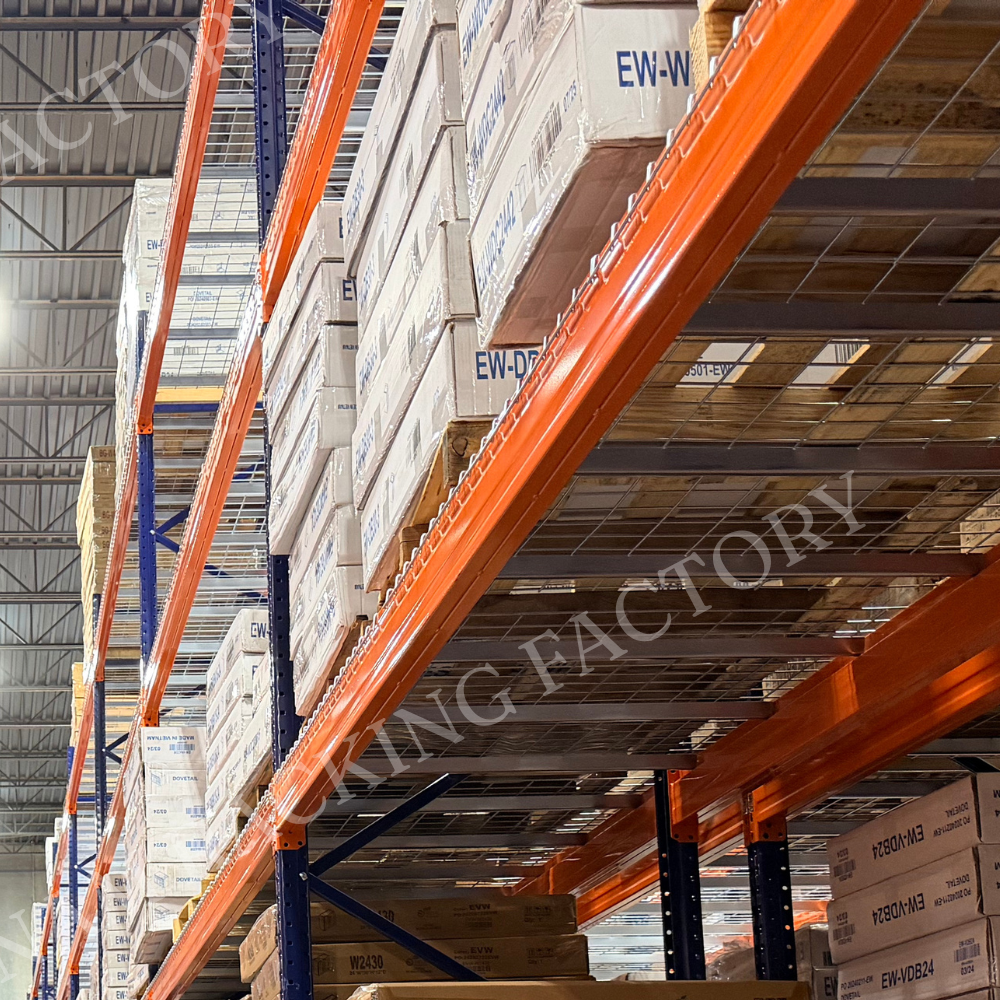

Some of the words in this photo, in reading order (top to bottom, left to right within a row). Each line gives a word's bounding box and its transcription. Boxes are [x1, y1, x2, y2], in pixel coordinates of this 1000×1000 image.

[945, 802, 968, 818] DOVETAIL
[872, 824, 924, 860] EW-VDB24
[945, 873, 969, 889] DOVETAIL
[872, 893, 925, 926] EW-VDB24
[350, 955, 383, 970] W2430
[881, 959, 934, 989] EW-VDB24
